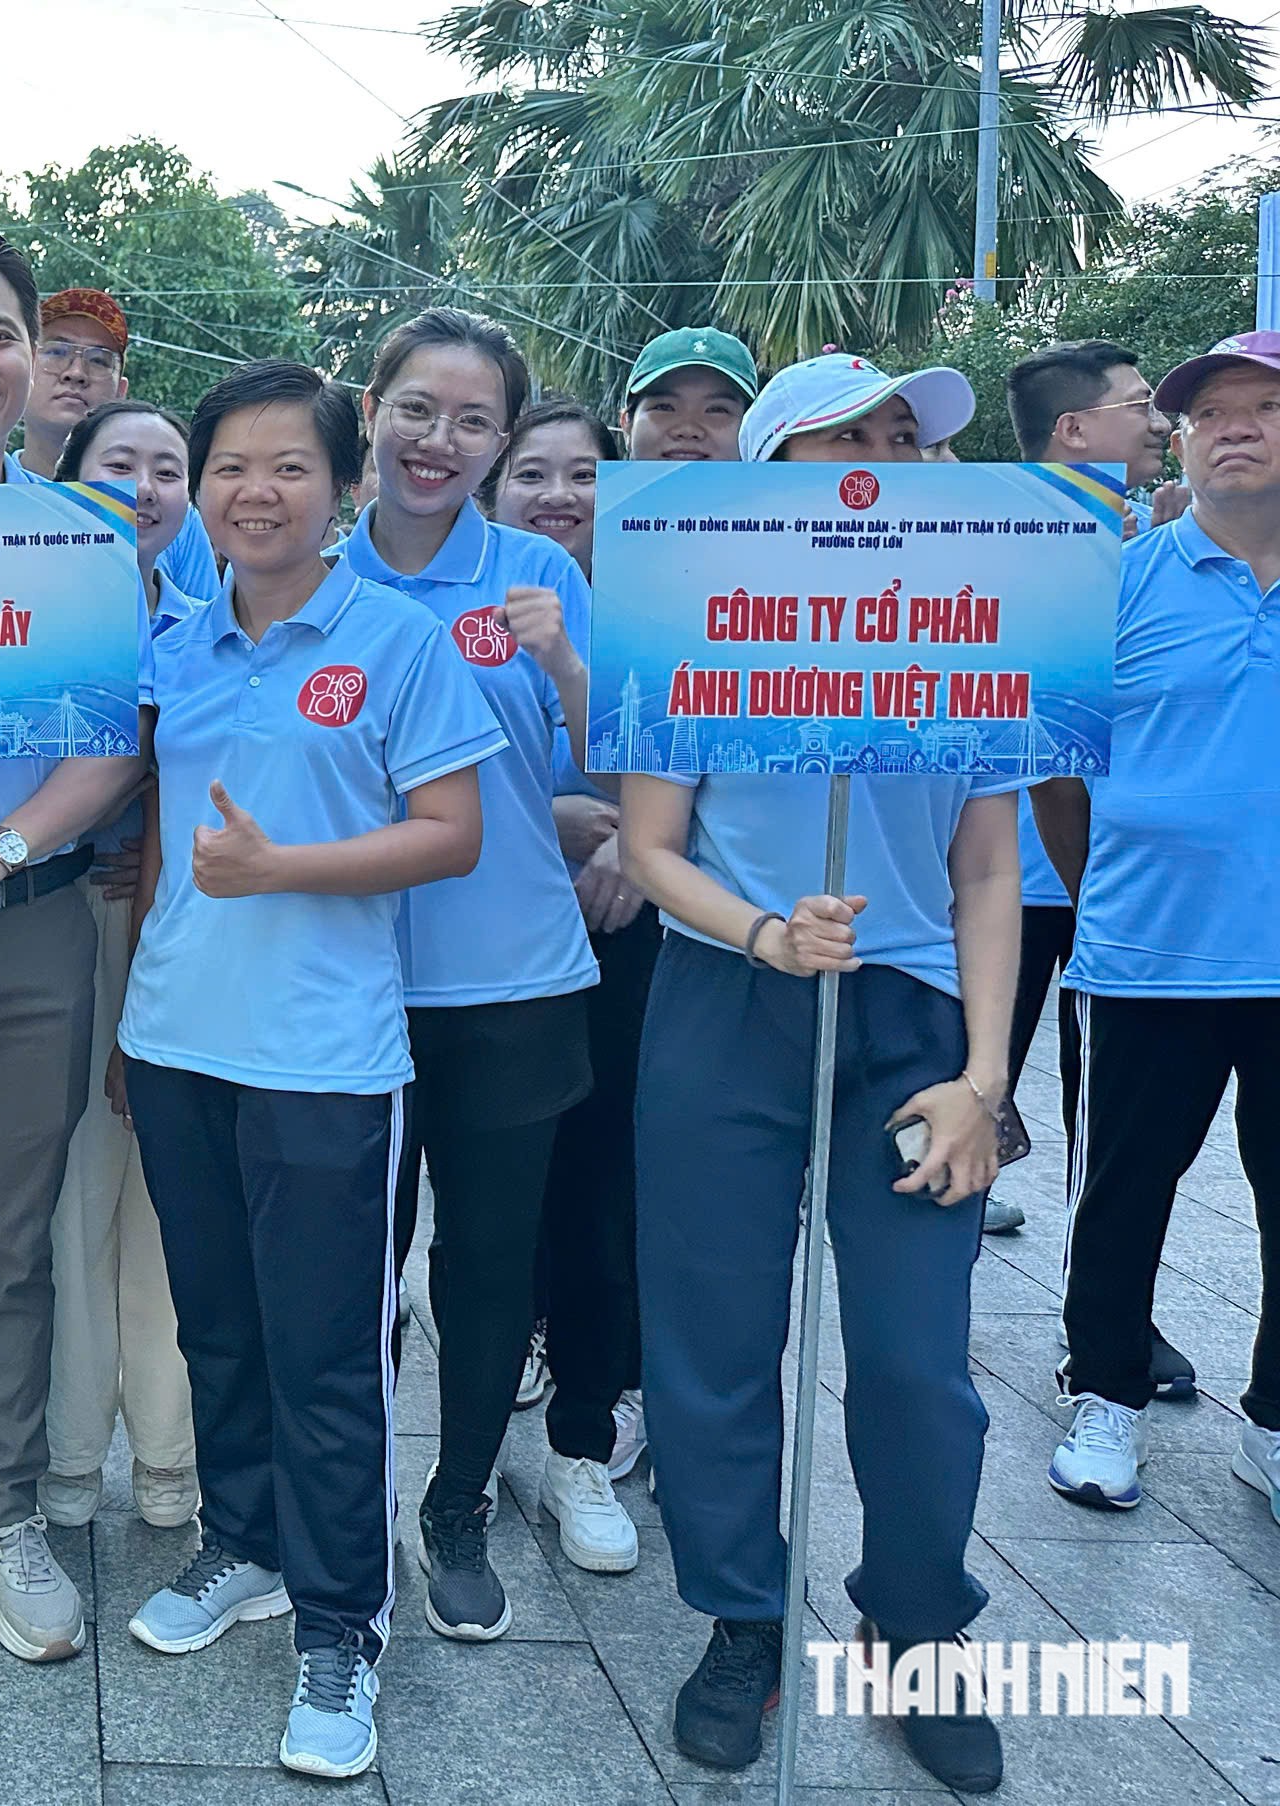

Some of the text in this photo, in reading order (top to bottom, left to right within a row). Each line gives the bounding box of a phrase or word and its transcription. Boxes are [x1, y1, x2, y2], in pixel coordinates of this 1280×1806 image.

[677, 518, 696, 533] HỘI
[699, 516, 729, 532] ĐỒNG
[731, 518, 760, 532] NHÂN
[763, 518, 785, 532] DÂN
[811, 520, 832, 532] BAN
[836, 519, 865, 532] NHÂN
[867, 519, 889, 533] DÂN
[916, 521, 938, 533] BAN
[966, 519, 994, 536] TRẬN
[1014, 518, 1044, 535] QUỐC
[1047, 519, 1070, 536] VIỆT
[1072, 522, 1097, 533] NAM
[2, 533, 27, 548] TRẬN
[43, 531, 69, 546] QUỐC
[71, 532, 91, 546] VIỆT
[94, 533, 115, 544] NAM
[811, 534, 903, 550] PHƯỜNG CHỢ LỚN
[706, 578, 1000, 644] CÔNG TY CỔ PHẦN
[668, 661, 1030, 729] ÁNH DƯƠNG VIỆT NAM
